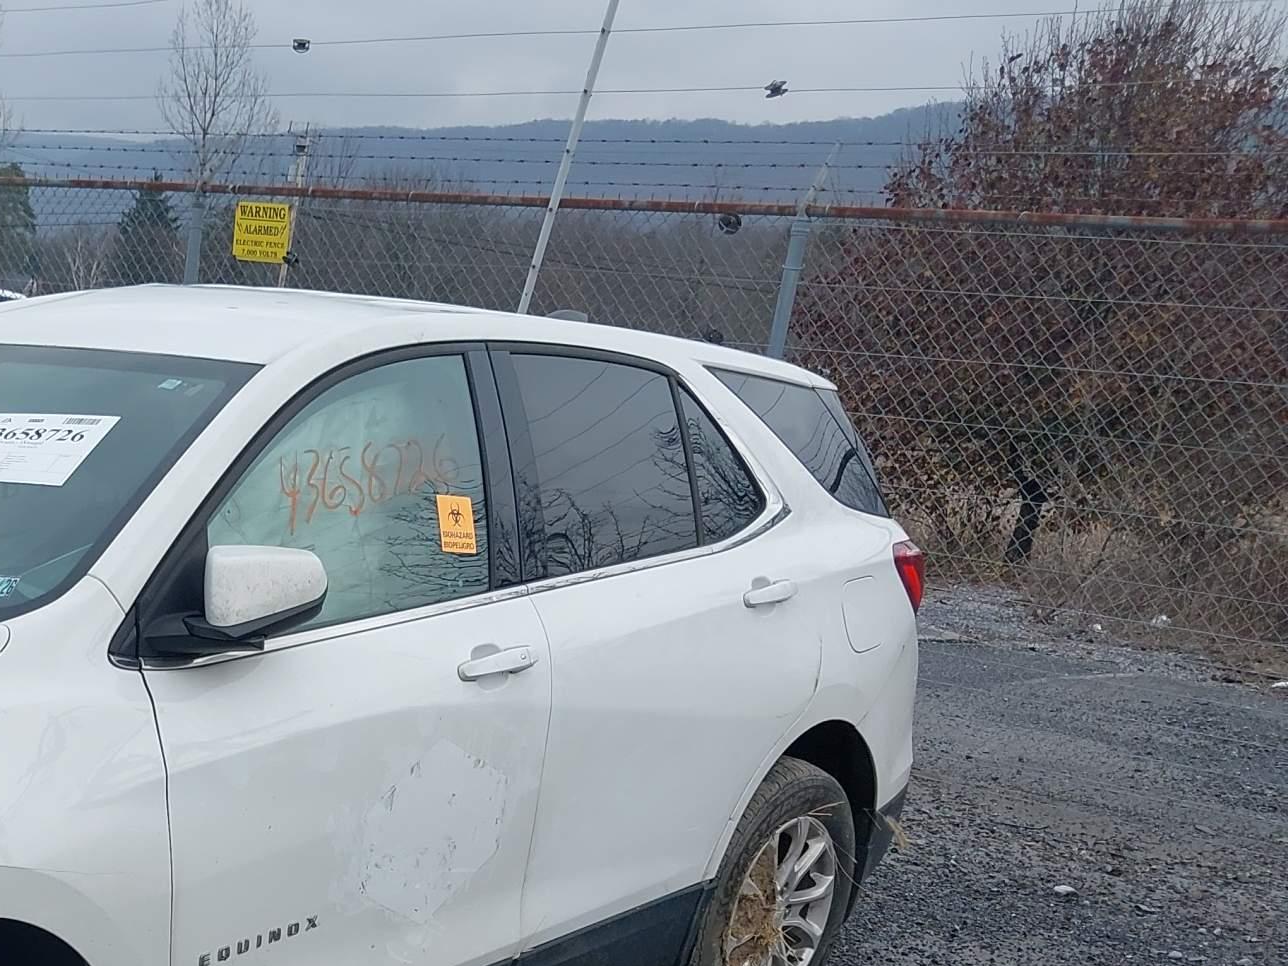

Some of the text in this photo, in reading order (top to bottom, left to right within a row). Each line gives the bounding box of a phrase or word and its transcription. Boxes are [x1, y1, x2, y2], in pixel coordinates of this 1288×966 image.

[240, 205, 286, 220] WARNING
[243, 224, 280, 237] ALARMED
[235, 238, 285, 249] ELECTRIC FENCE
[242, 248, 278, 258] 7,000 VOLTS
[279, 432, 460, 536] 43658726
